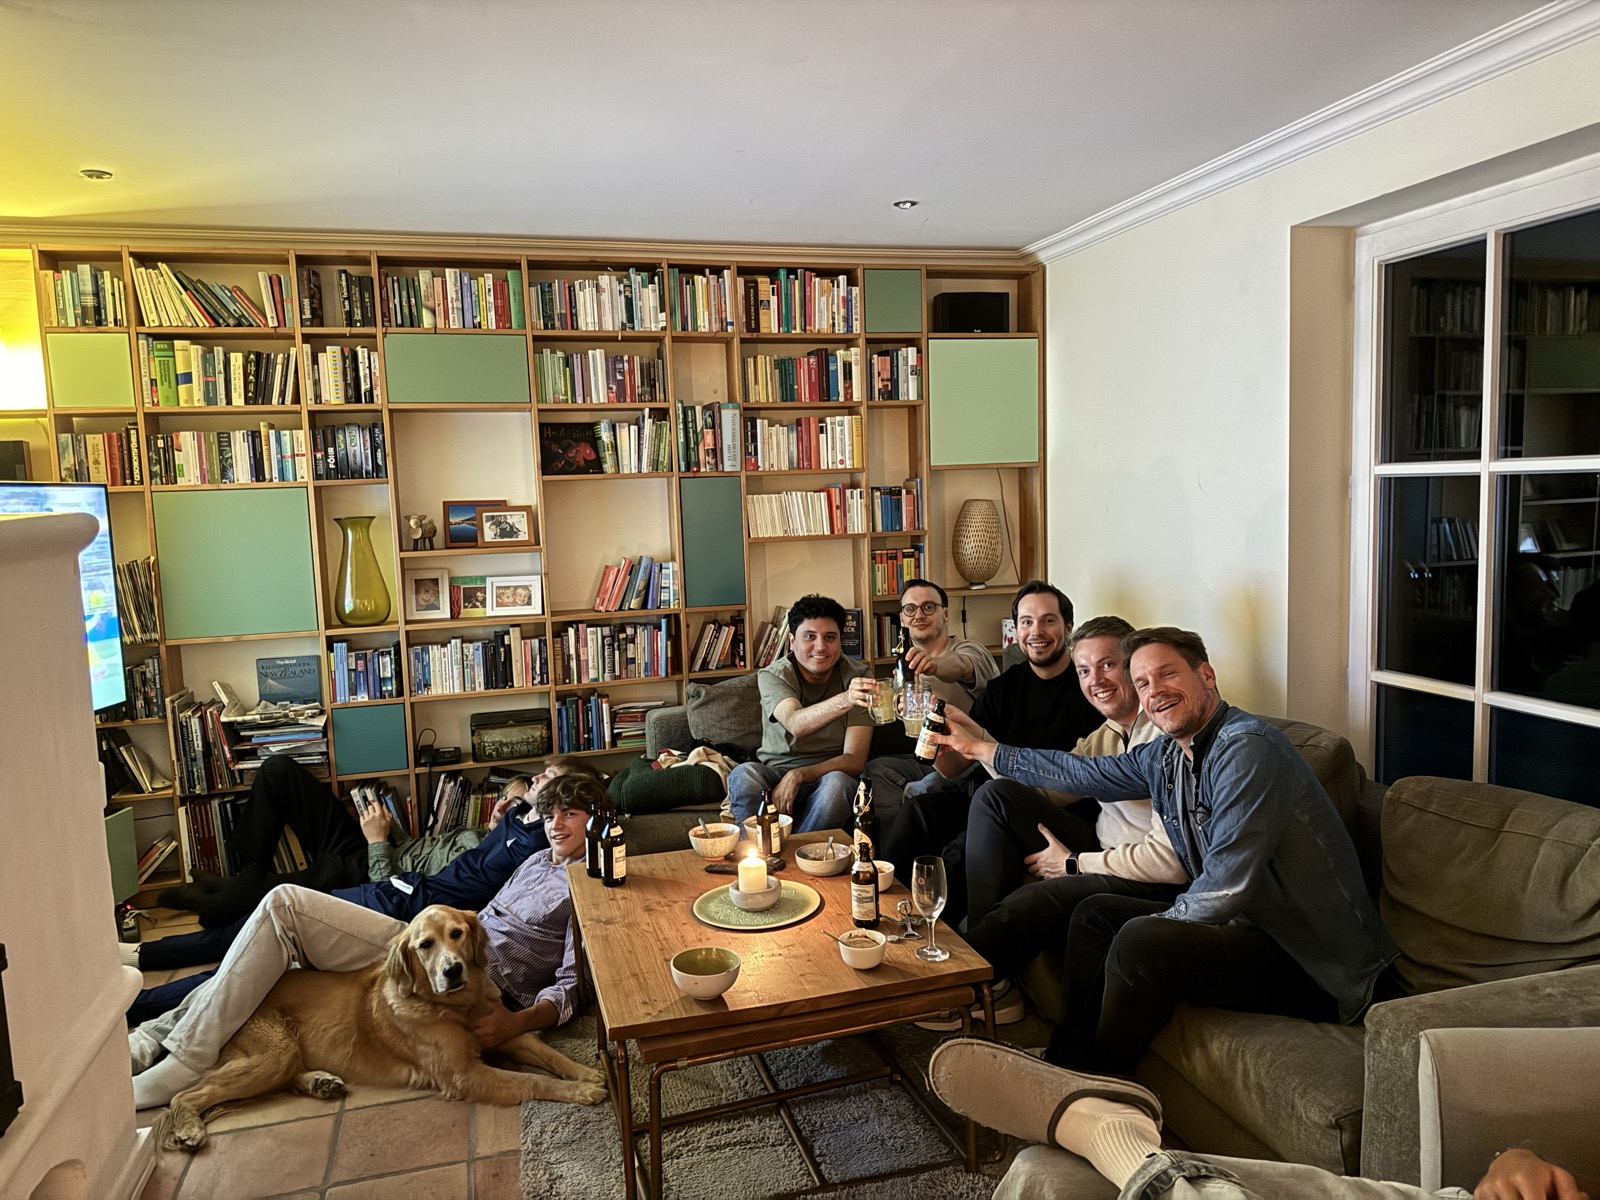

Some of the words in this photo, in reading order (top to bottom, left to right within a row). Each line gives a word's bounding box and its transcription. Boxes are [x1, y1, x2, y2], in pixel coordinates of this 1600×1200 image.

[349, 429, 357, 447] OXEN
[327, 447, 335, 468] FÖHR
[259, 670, 278, 678] NEW
[278, 668, 315, 677] ZEALAND
